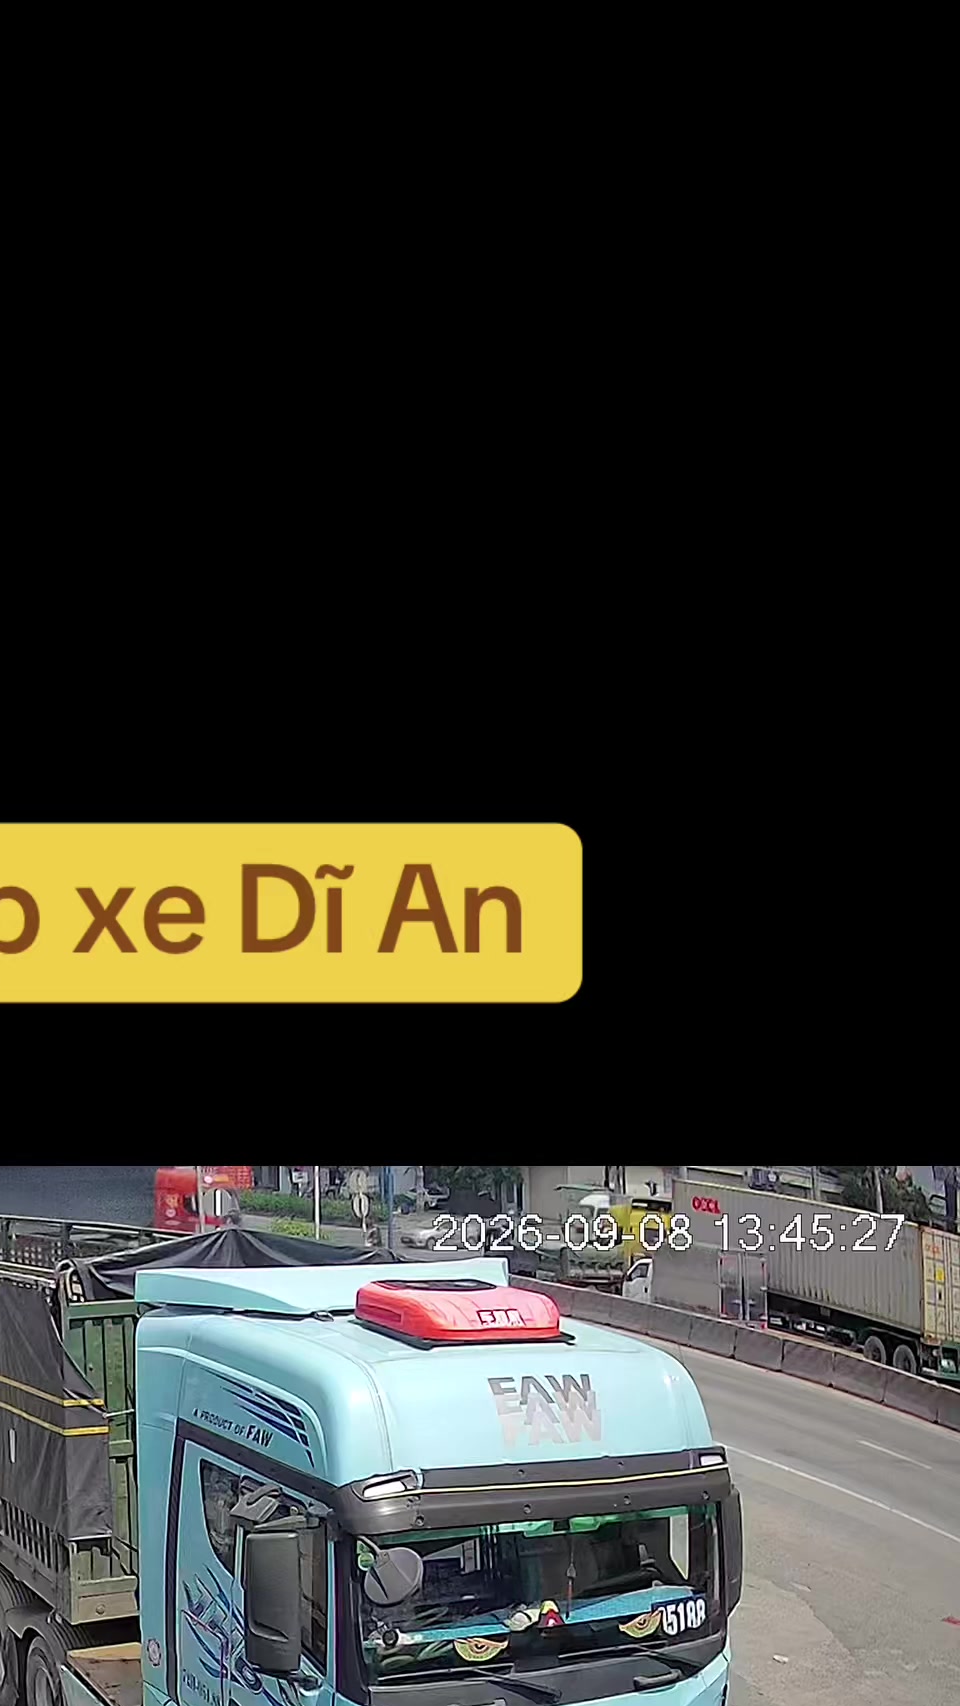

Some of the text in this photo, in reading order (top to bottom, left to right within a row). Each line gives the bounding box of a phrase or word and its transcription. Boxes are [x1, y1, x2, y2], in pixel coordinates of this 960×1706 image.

[200, 1410, 234, 1431] PRODUCT
[235, 1423, 245, 1436] OF
[246, 1425, 274, 1448] FAW
